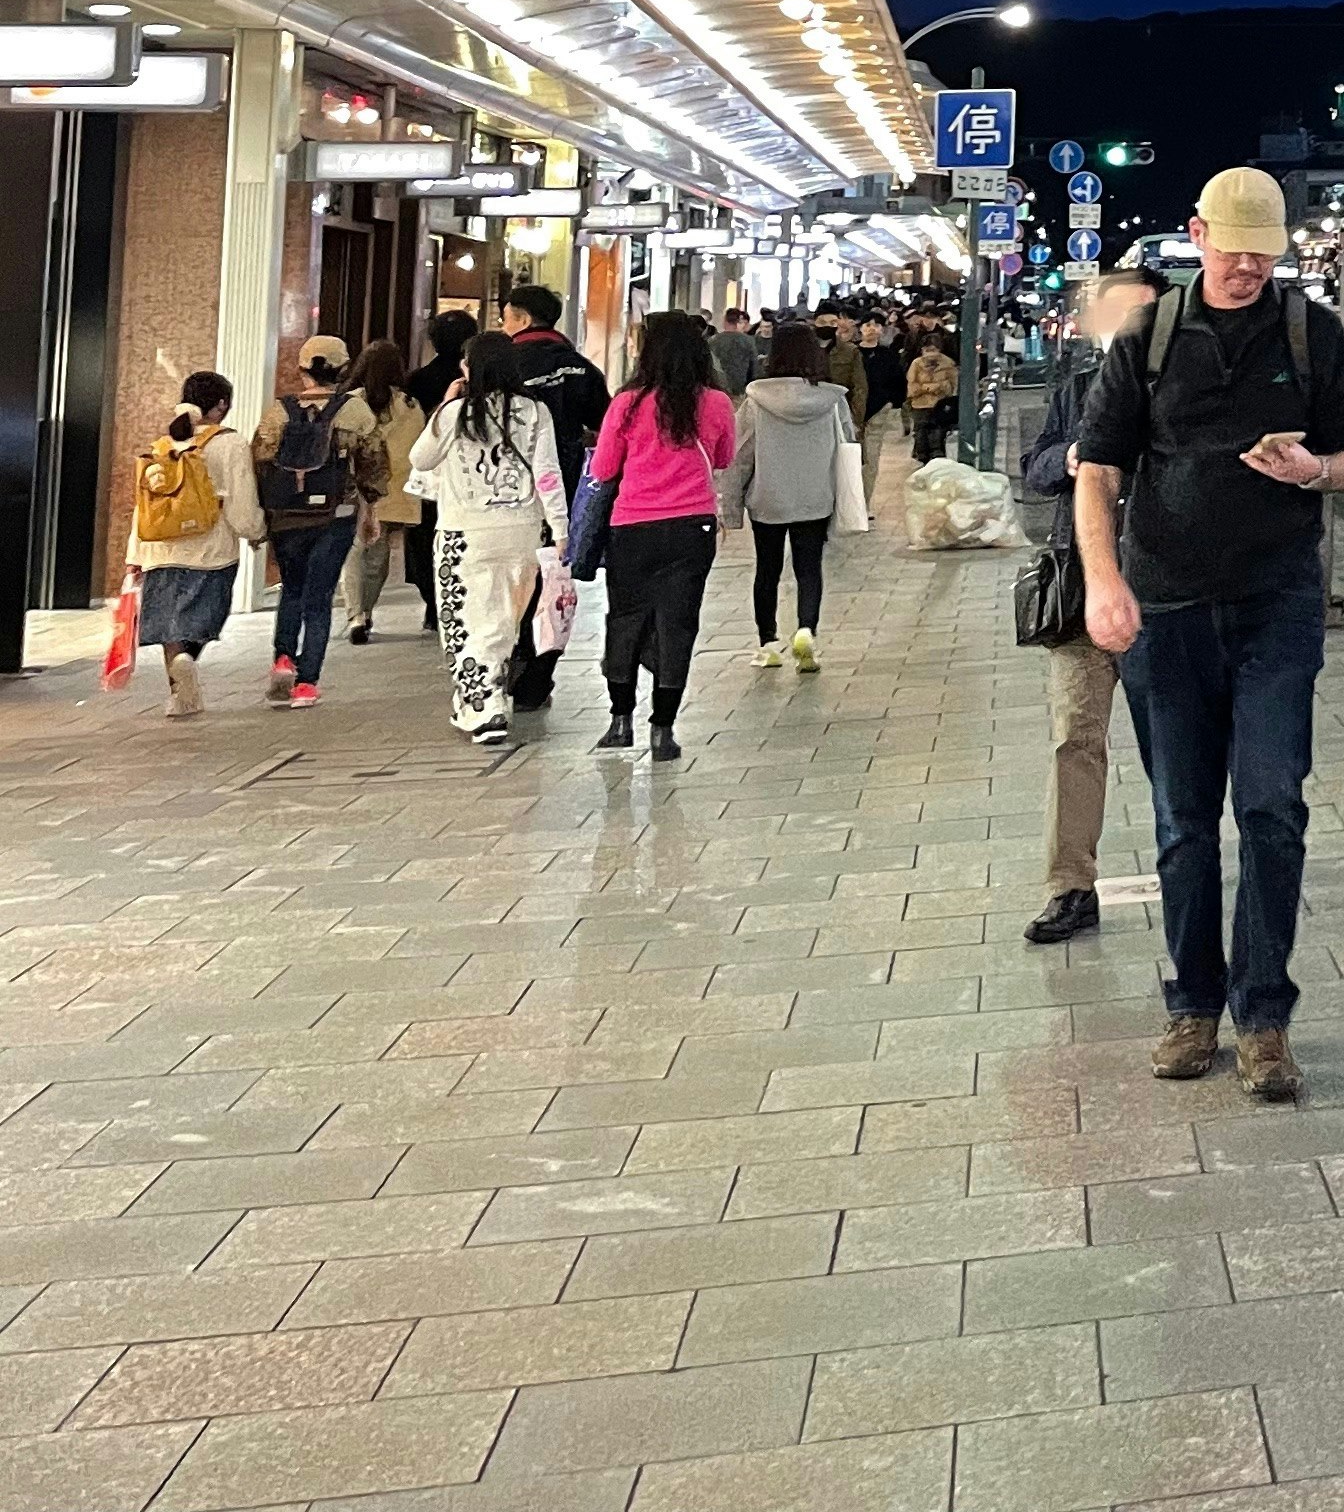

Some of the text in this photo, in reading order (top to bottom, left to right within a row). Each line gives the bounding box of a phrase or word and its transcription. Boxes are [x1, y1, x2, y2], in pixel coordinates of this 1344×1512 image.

[947, 103, 1001, 155] 停
[957, 175, 1006, 192] ここから
[981, 211, 1010, 235] 停
